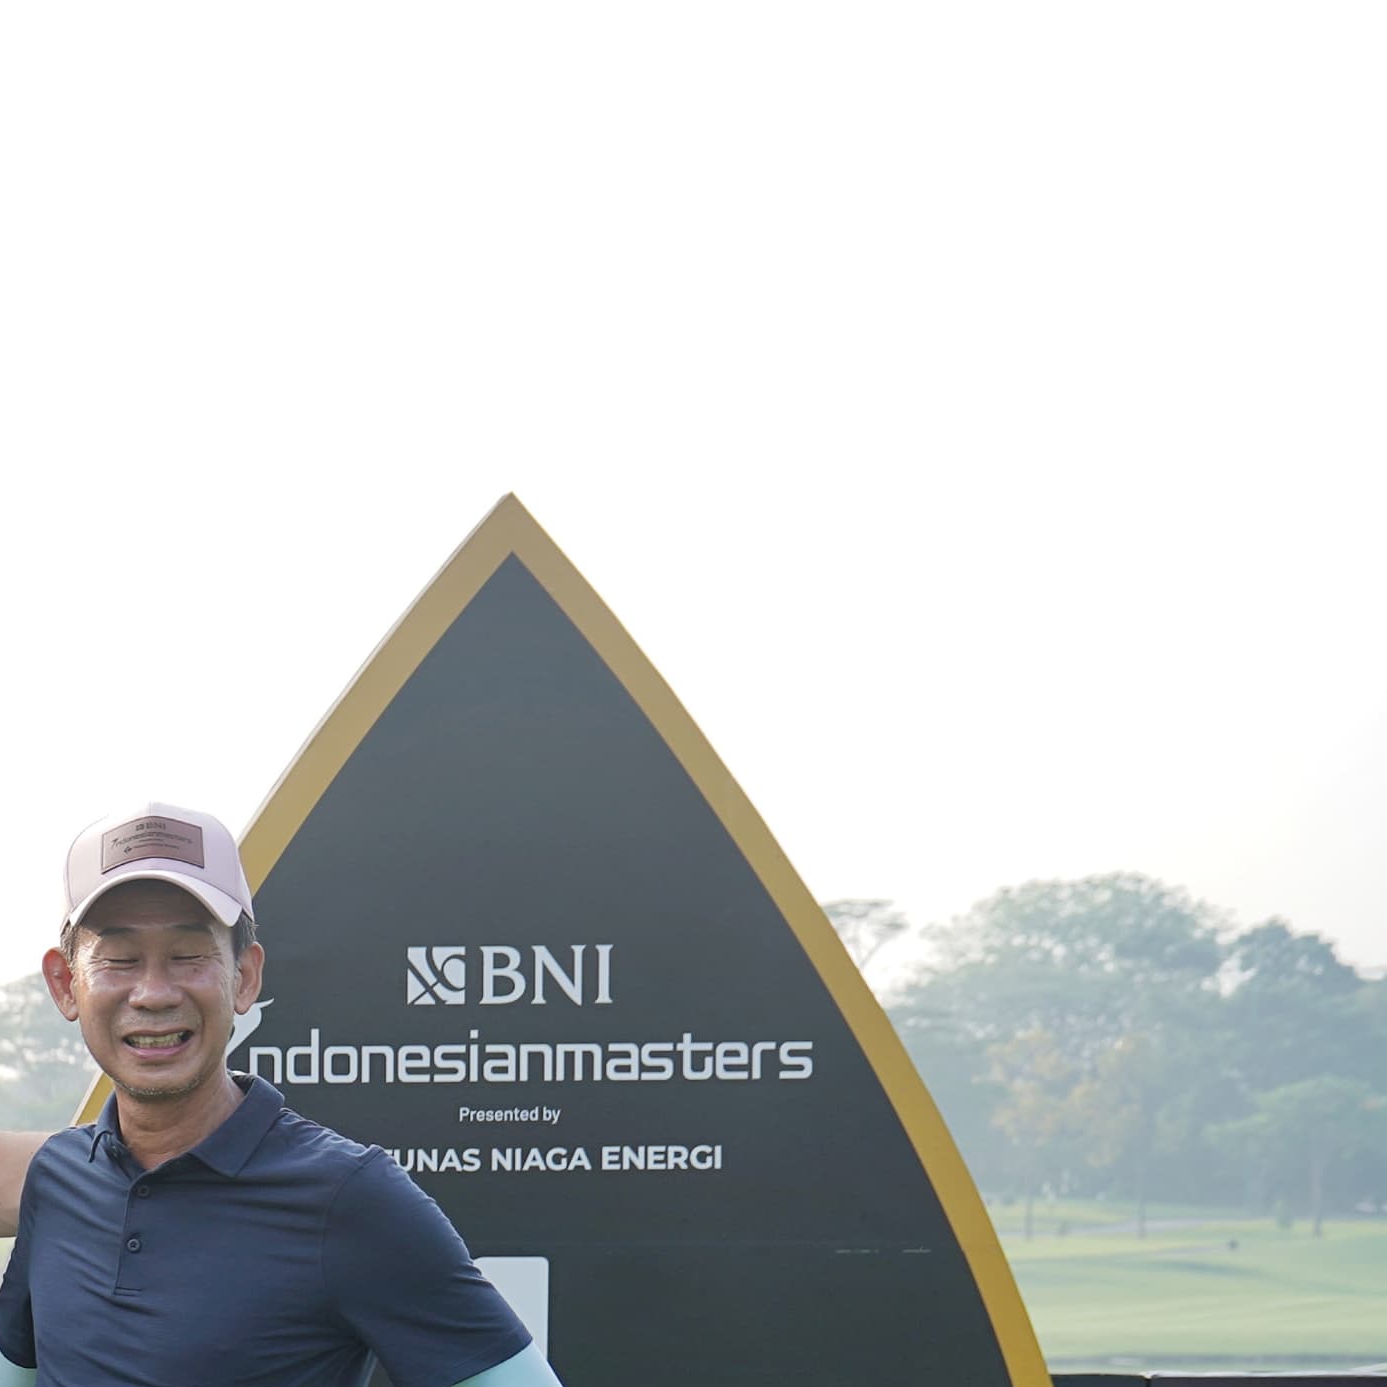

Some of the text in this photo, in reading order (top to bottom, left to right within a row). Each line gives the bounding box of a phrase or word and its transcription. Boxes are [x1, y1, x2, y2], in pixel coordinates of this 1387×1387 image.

[479, 944, 614, 1006] BNI
[458, 1106, 561, 1125] Presented by
[491, 1146, 591, 1172] NIAGA
[601, 1144, 722, 1171] ENERGI
